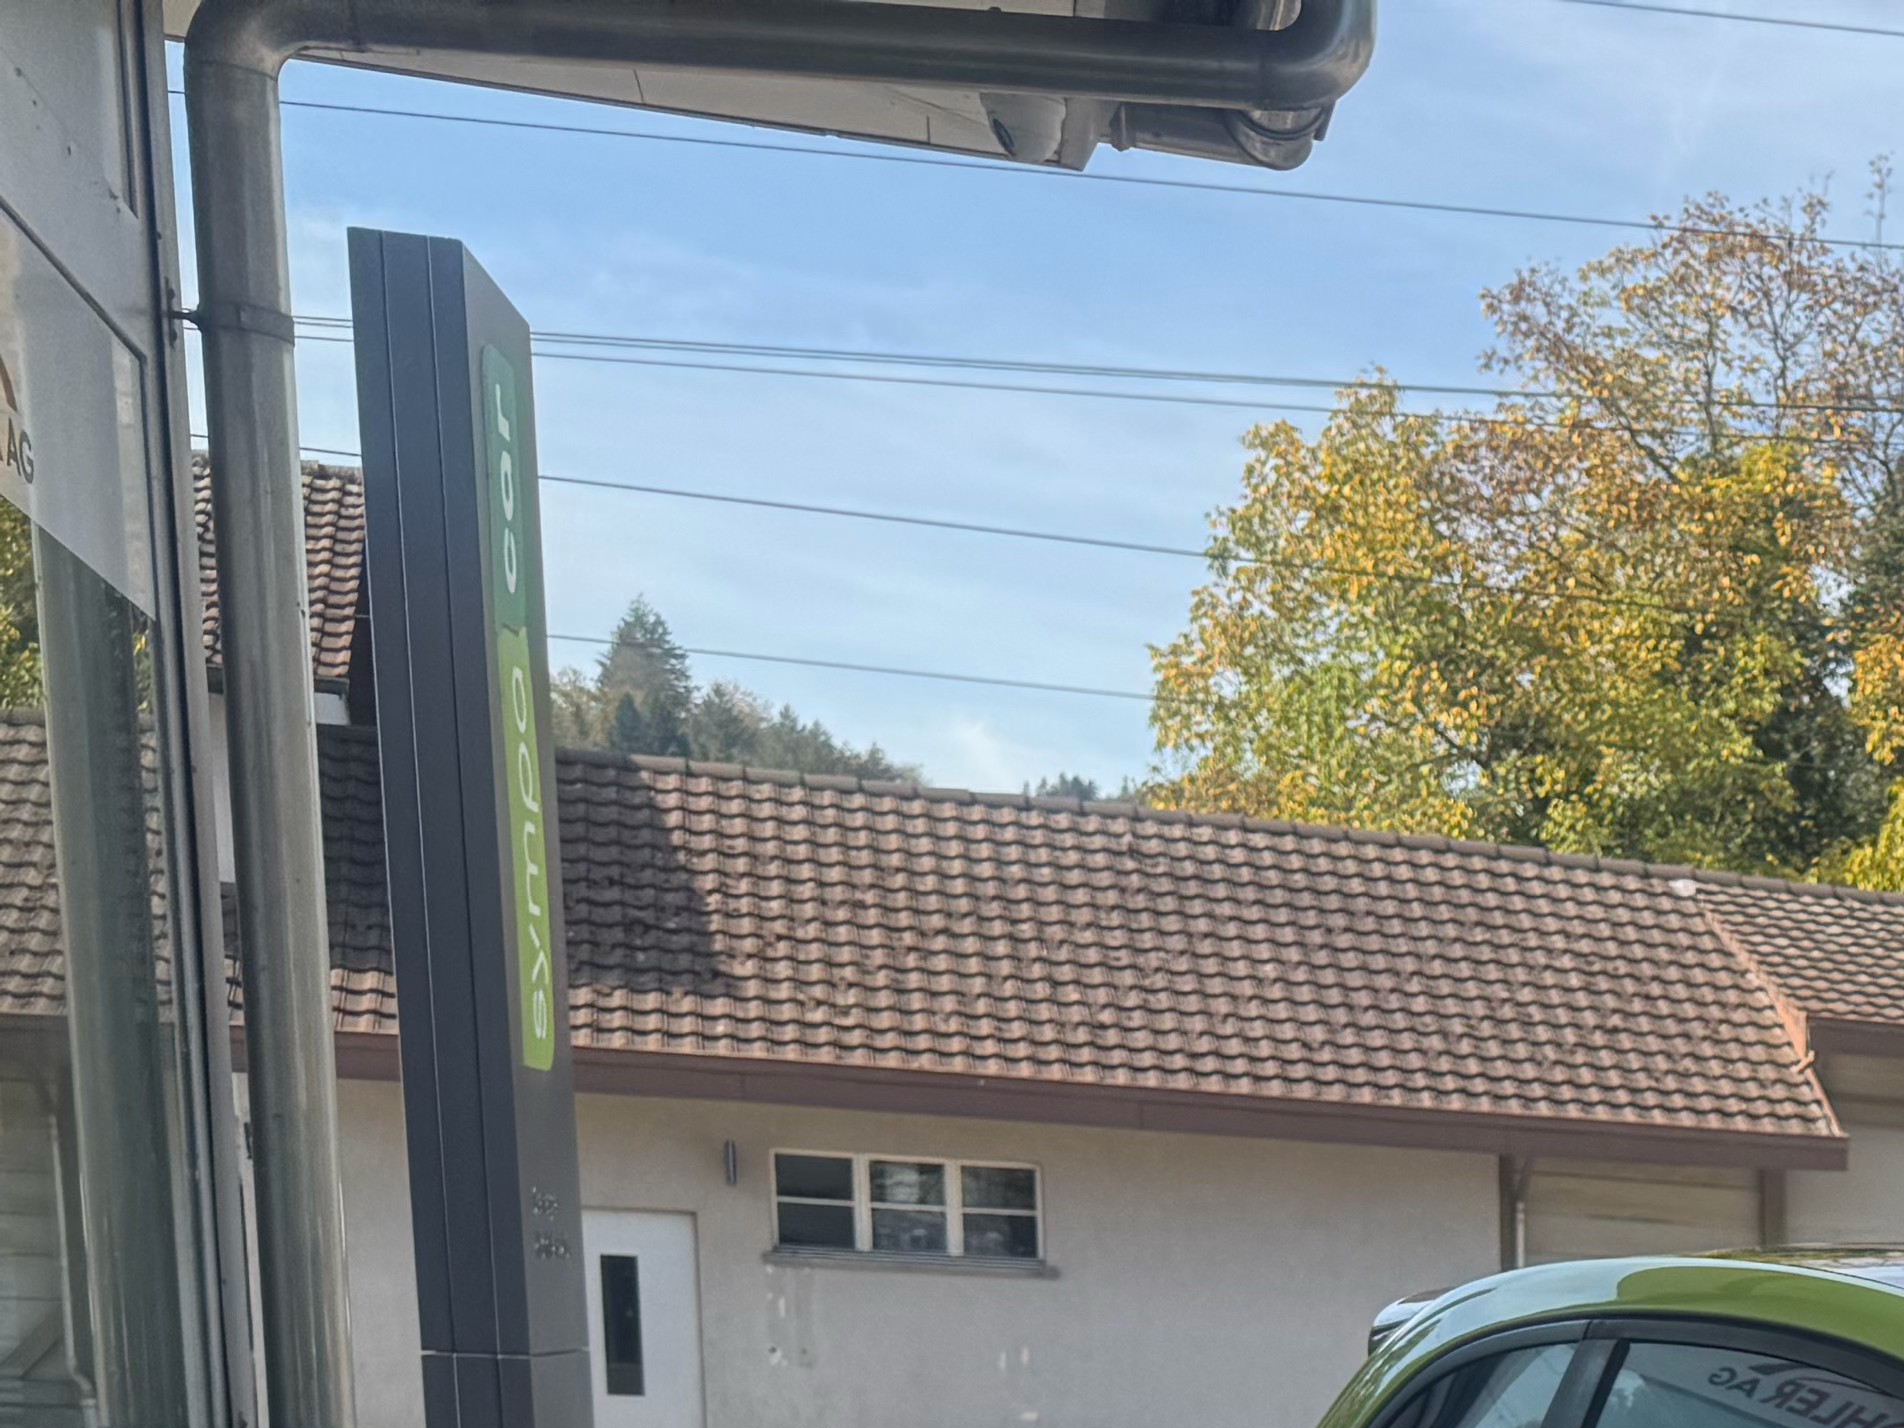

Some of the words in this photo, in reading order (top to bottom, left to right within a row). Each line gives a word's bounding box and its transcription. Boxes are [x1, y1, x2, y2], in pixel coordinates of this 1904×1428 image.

[6, 416, 35, 485] AG
[495, 383, 517, 595] car
[511, 665, 549, 1042] sympa
